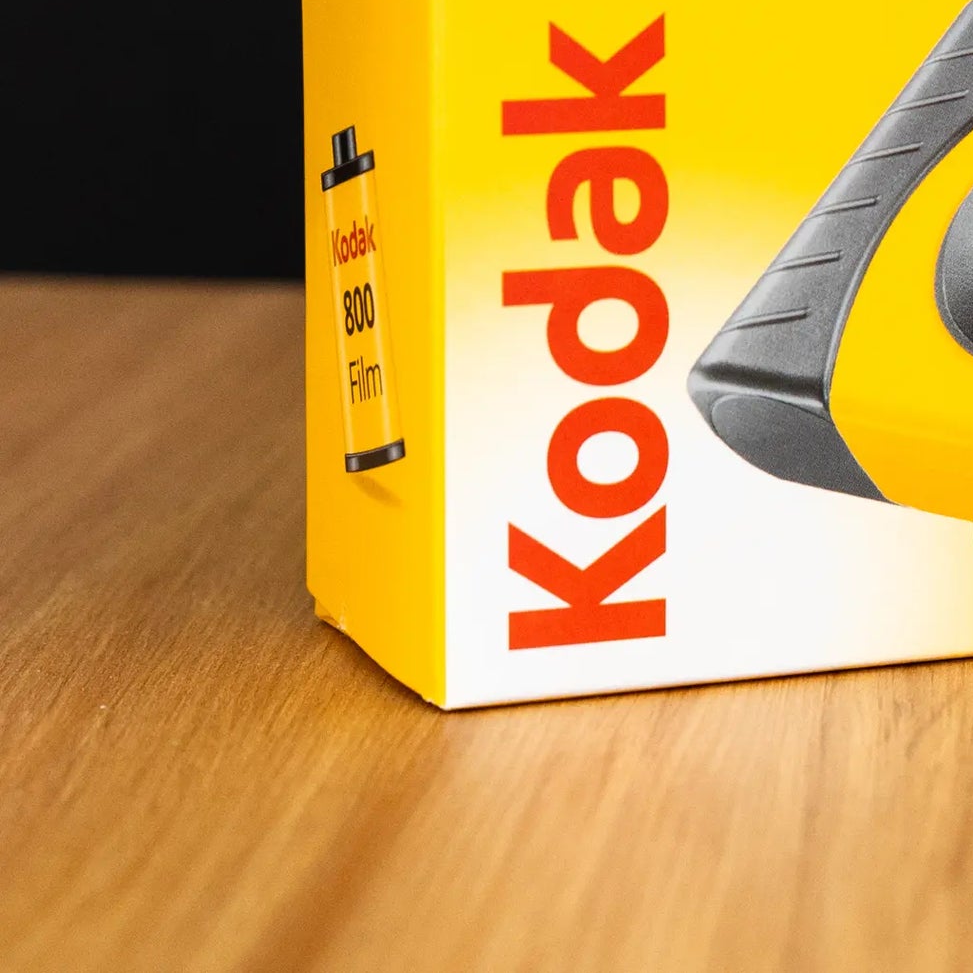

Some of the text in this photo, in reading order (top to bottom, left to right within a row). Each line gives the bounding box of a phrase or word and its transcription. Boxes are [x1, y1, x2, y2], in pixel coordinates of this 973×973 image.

[331, 215, 376, 267] Kodak
[343, 282, 375, 336] 800
[501, 12, 670, 651] Kodak
[348, 356, 383, 404] Film
